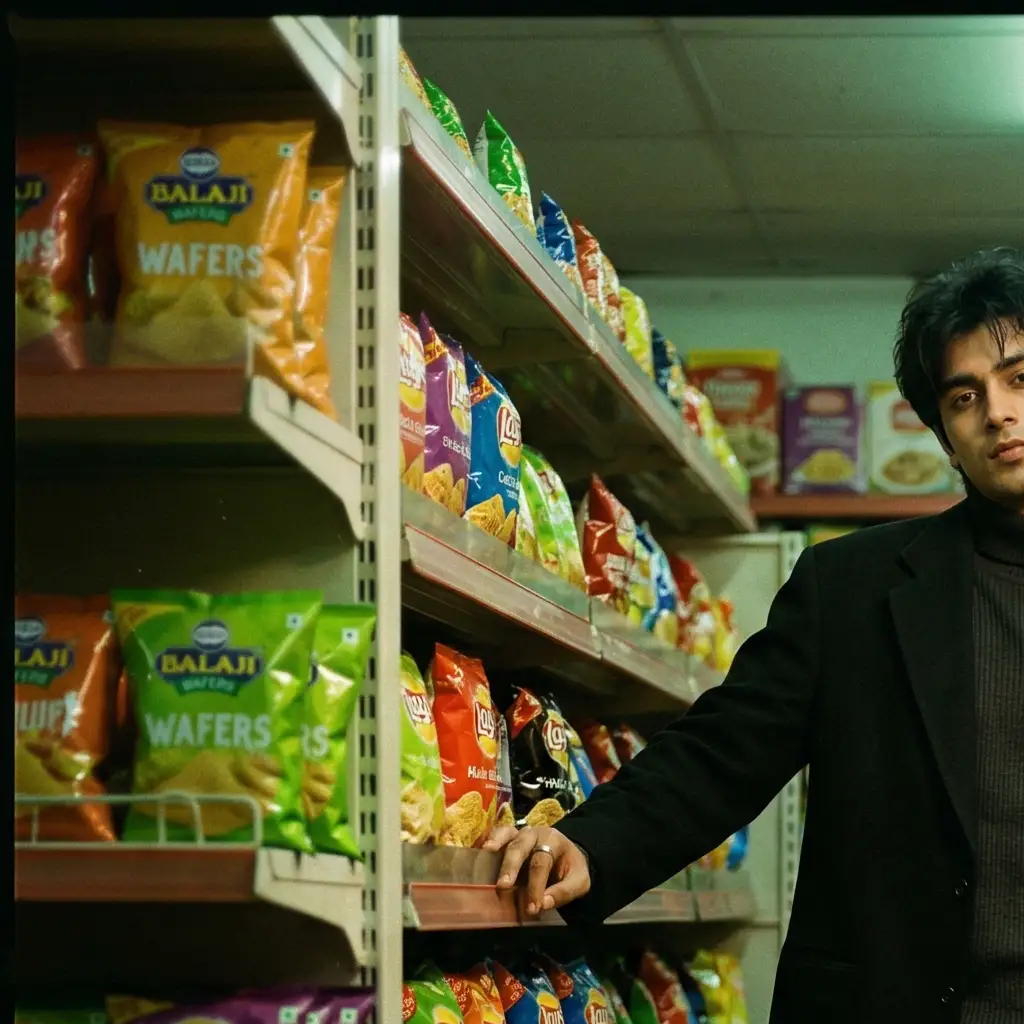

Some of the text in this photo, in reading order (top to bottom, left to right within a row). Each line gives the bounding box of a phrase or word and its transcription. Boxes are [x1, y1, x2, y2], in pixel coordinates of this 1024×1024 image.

[151, 183, 249, 203] BALAJI
[138, 241, 265, 279] WAFERS
[160, 654, 257, 675] BALAJI
[145, 711, 272, 752] WAFERS
